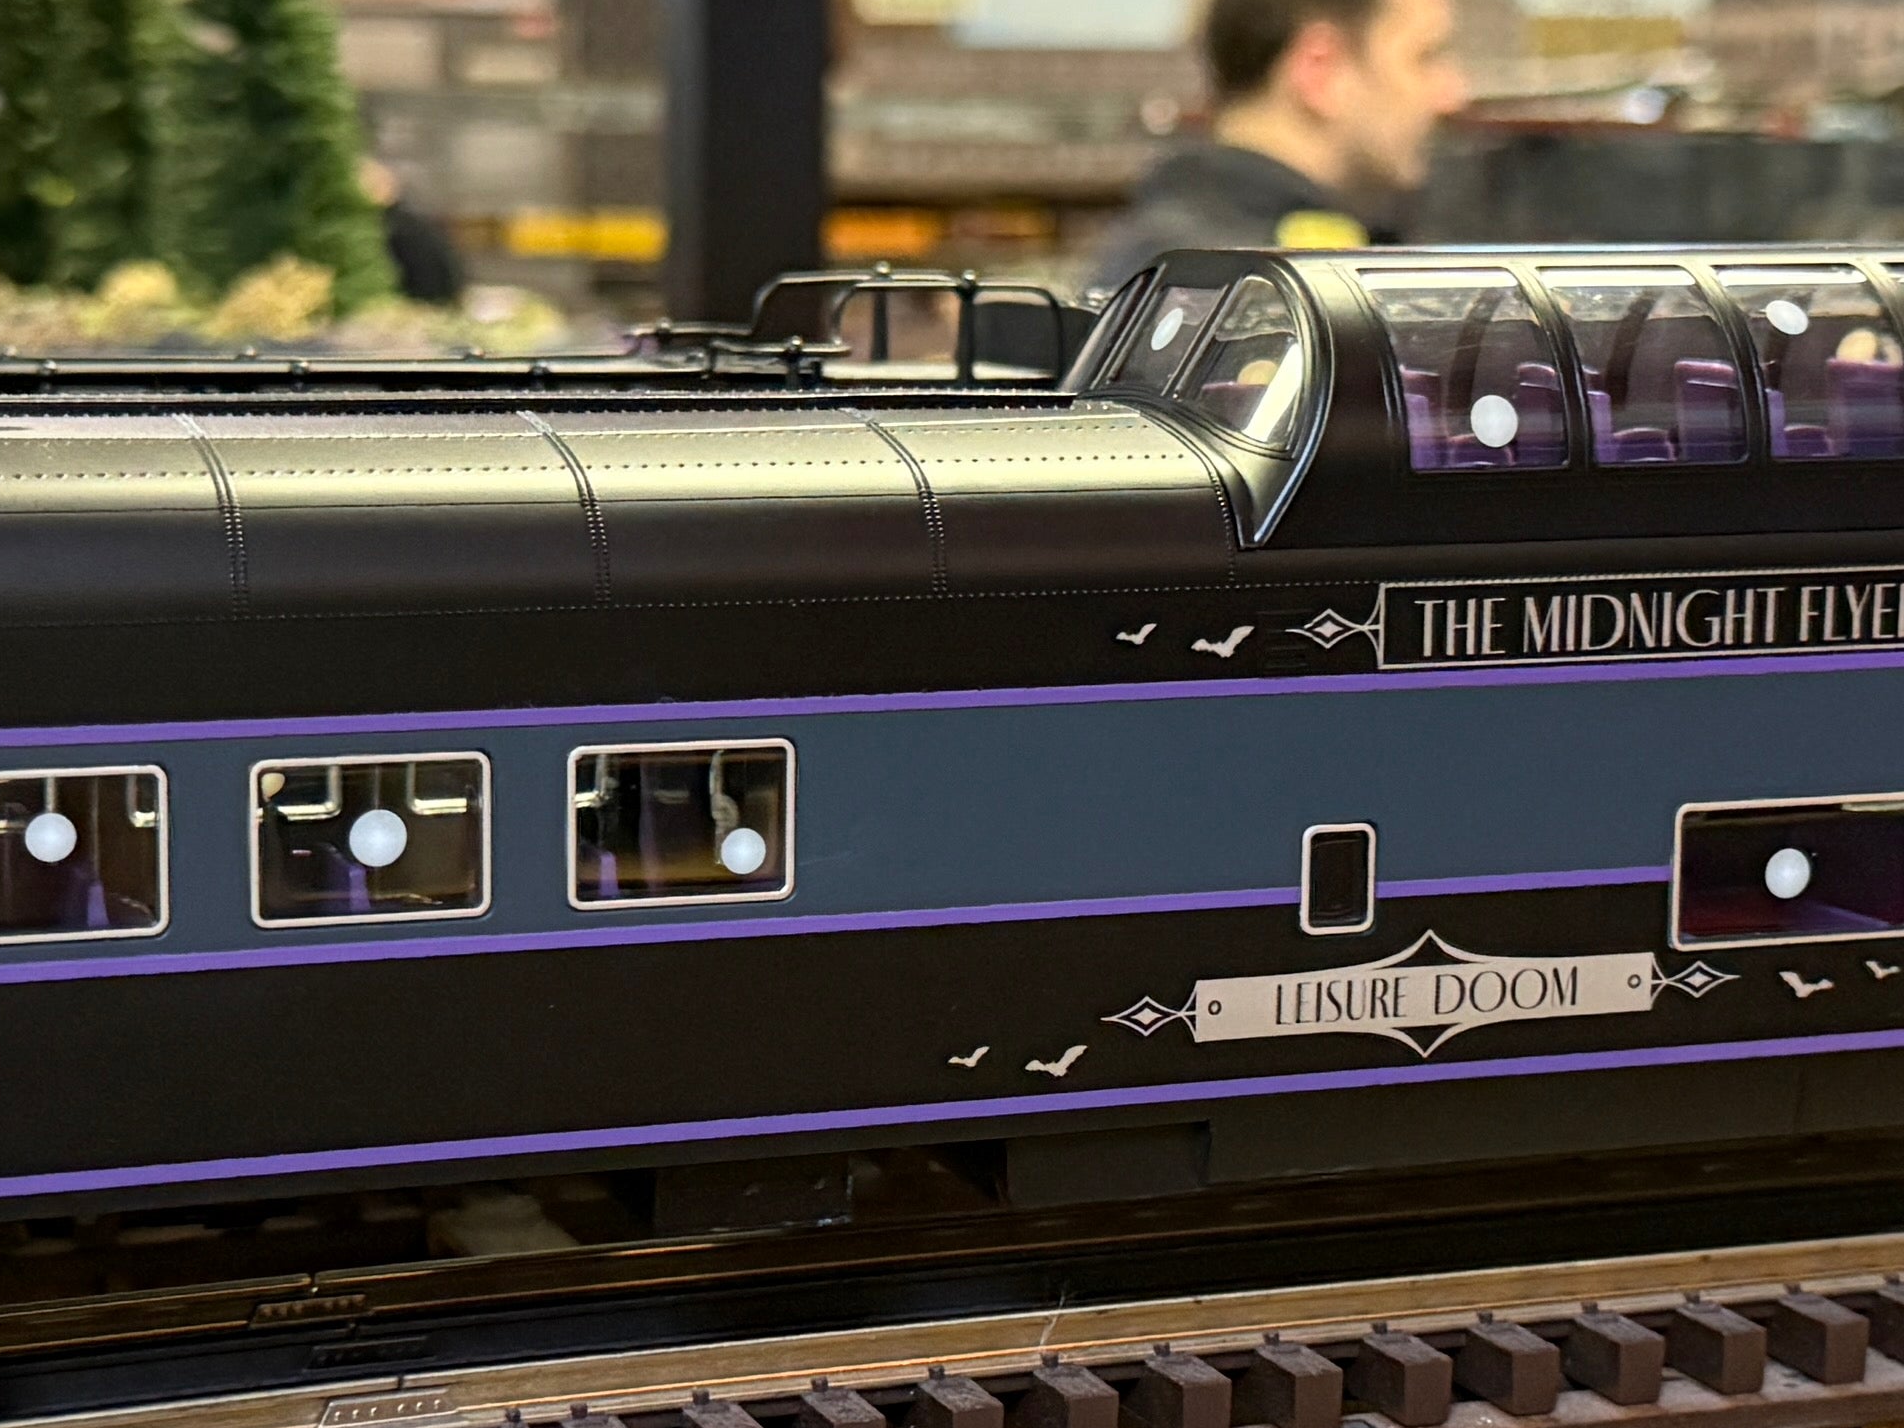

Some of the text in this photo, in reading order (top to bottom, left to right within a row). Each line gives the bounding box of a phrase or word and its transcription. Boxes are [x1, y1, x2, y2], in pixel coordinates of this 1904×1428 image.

[1413, 597, 1507, 657] THE
[1523, 586, 1787, 654] MIDNIGHT
[1275, 965, 1579, 1026] LEISURE DOOM
